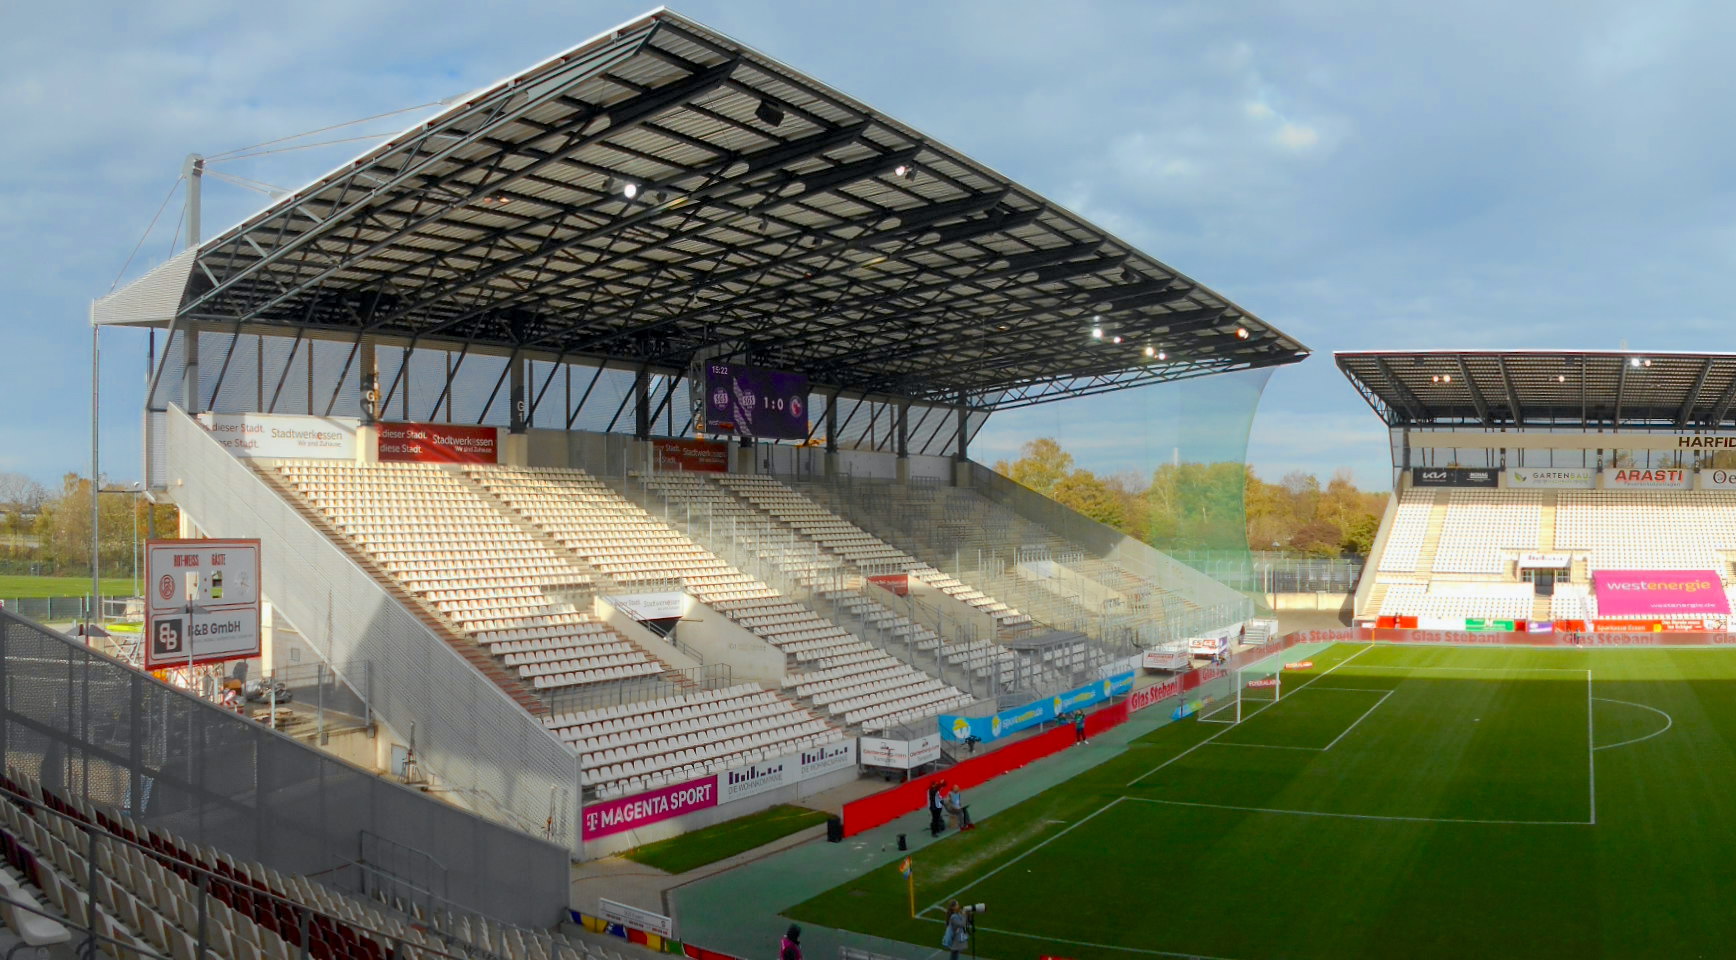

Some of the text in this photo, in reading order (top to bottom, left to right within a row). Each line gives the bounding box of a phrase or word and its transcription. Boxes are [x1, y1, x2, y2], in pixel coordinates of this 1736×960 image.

[711, 366, 728, 375] 15:22
[271, 428, 343, 440] Stadtwerkessen
[382, 430, 404, 439] dieser
[1615, 470, 1683, 482] ARASTI
[1607, 579, 1711, 593] westenergie
[210, 621, 241, 635] GmbH
[1412, 631, 1499, 643] Glas Stebani
[1597, 632, 1653, 645] Stebani
[1131, 691, 1149, 710] Glas
[1150, 681, 1179, 702] Stebani
[600, 793, 669, 829] MAGENTA
[670, 783, 713, 811] SPORT
